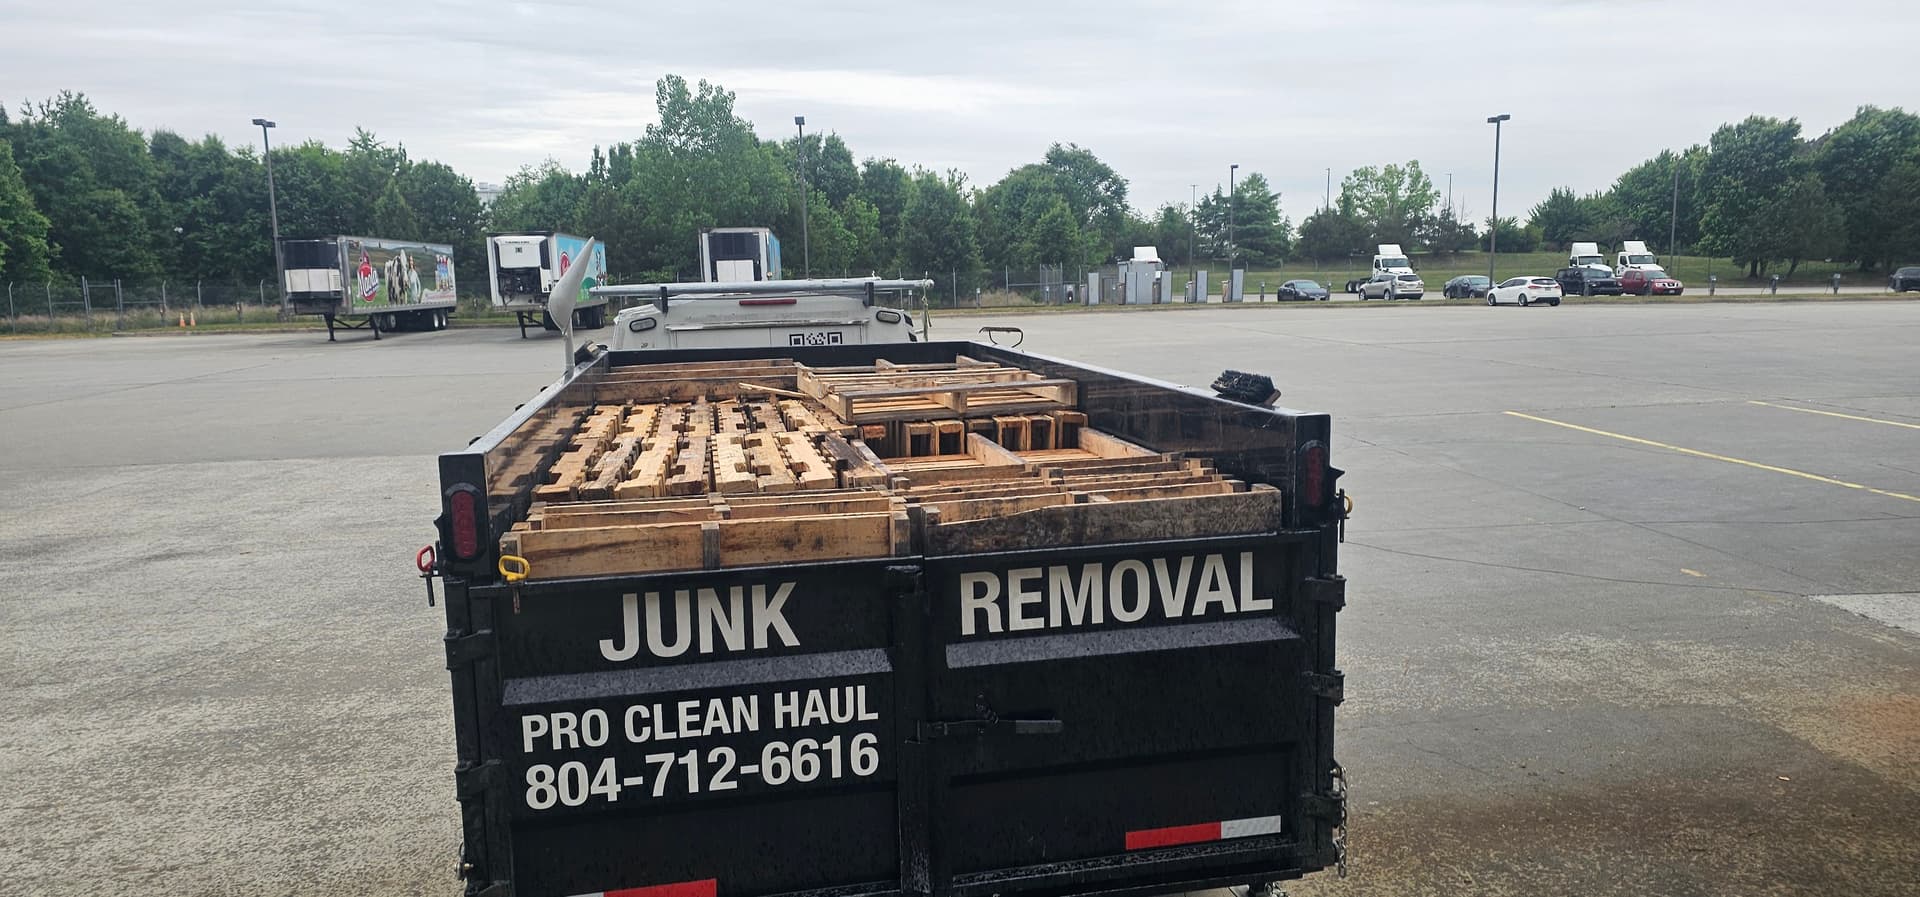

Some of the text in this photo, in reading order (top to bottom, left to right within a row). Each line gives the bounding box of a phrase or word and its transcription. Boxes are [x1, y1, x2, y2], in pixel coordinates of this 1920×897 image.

[600, 551, 1273, 662] JUNK REMOVAL
[522, 685, 878, 753] PRO CLEAN HAUL
[525, 732, 879, 810] 804-712-6616
